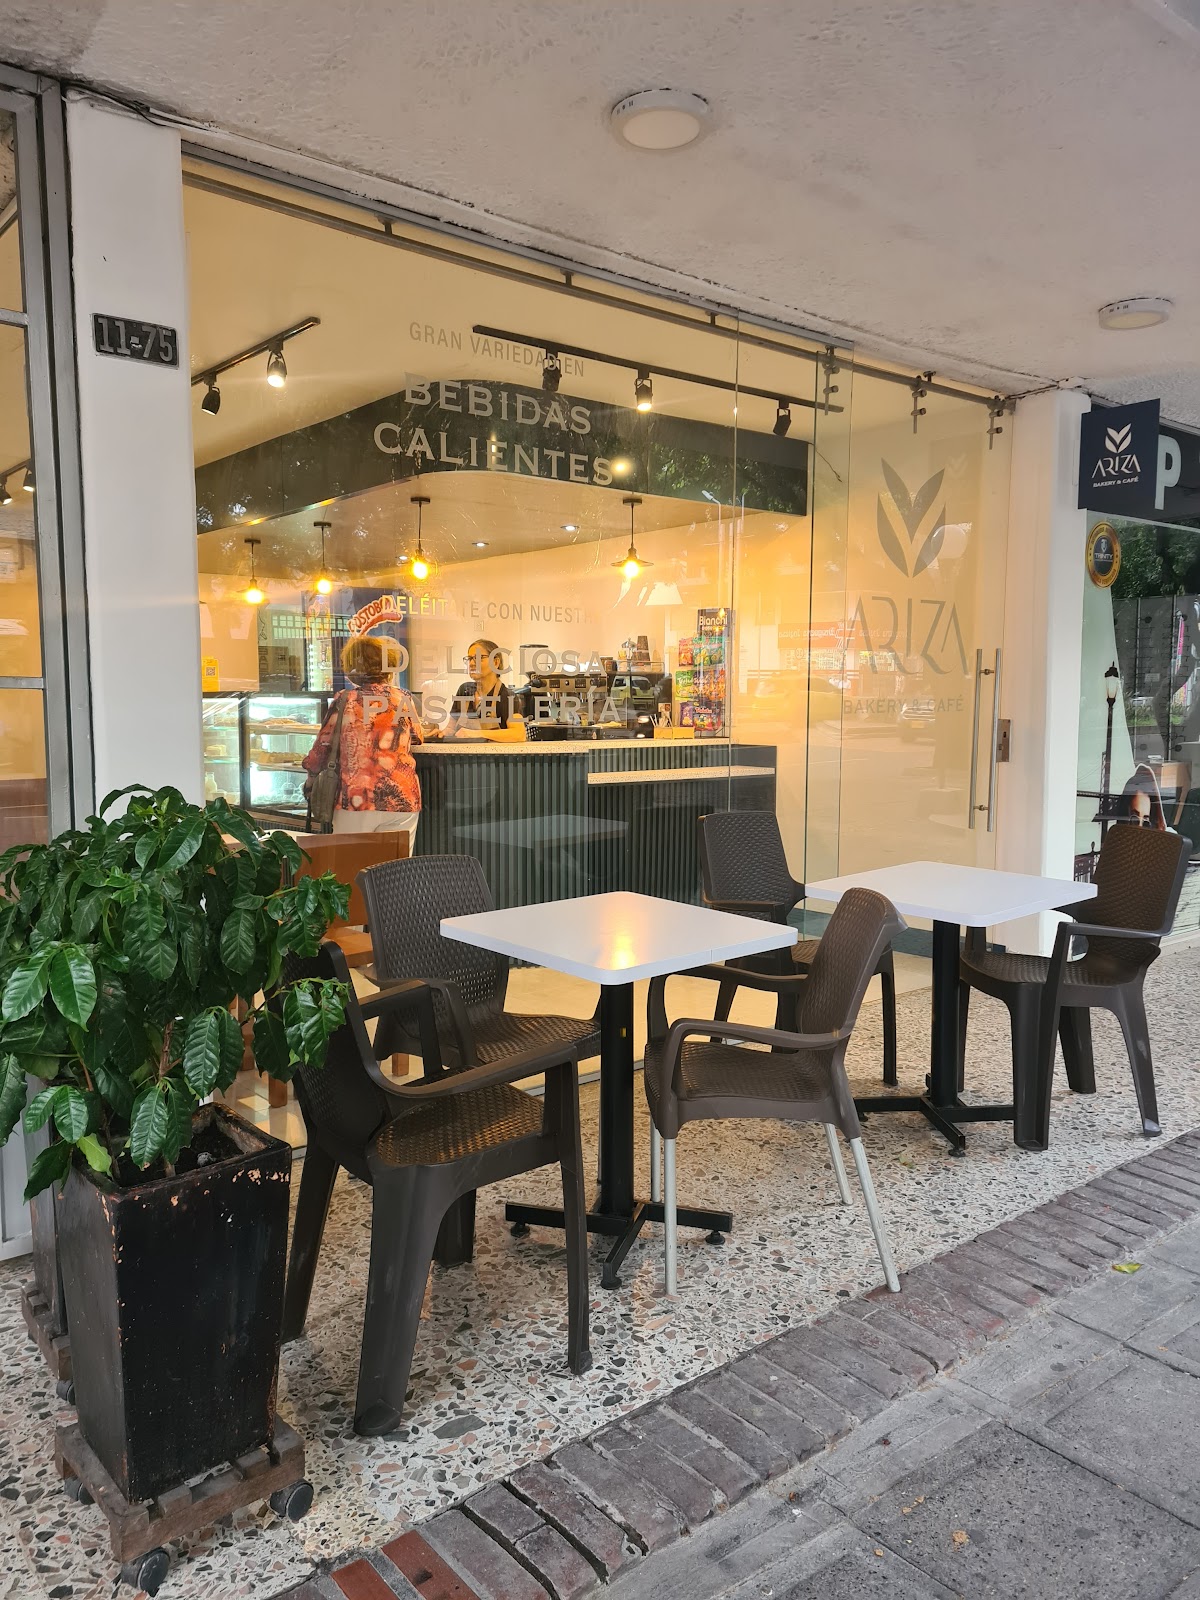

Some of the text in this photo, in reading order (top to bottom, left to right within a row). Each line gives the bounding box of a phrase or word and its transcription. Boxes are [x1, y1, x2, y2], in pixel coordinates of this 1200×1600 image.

[97, 317, 173, 362] 11-75
[409, 322, 585, 377] GRAN VARIEDAD EN
[403, 371, 592, 434] BEBIDAS
[373, 422, 614, 486] CALIENTES
[1091, 453, 1142, 479] ARIZA
[1093, 480, 1116, 488] BAKERY
[1122, 476, 1139, 484] CAFÉ
[487, 601, 523, 621] CON
[530, 604, 600, 624] NUESTR
[699, 615, 728, 626] Bianchi
[839, 595, 971, 675] ARIZA
[381, 643, 607, 677] DELICIOSA
[362, 685, 624, 725] PASTELERÍA
[843, 698, 907, 715] BAKERY
[927, 694, 965, 713] CAFÉ
